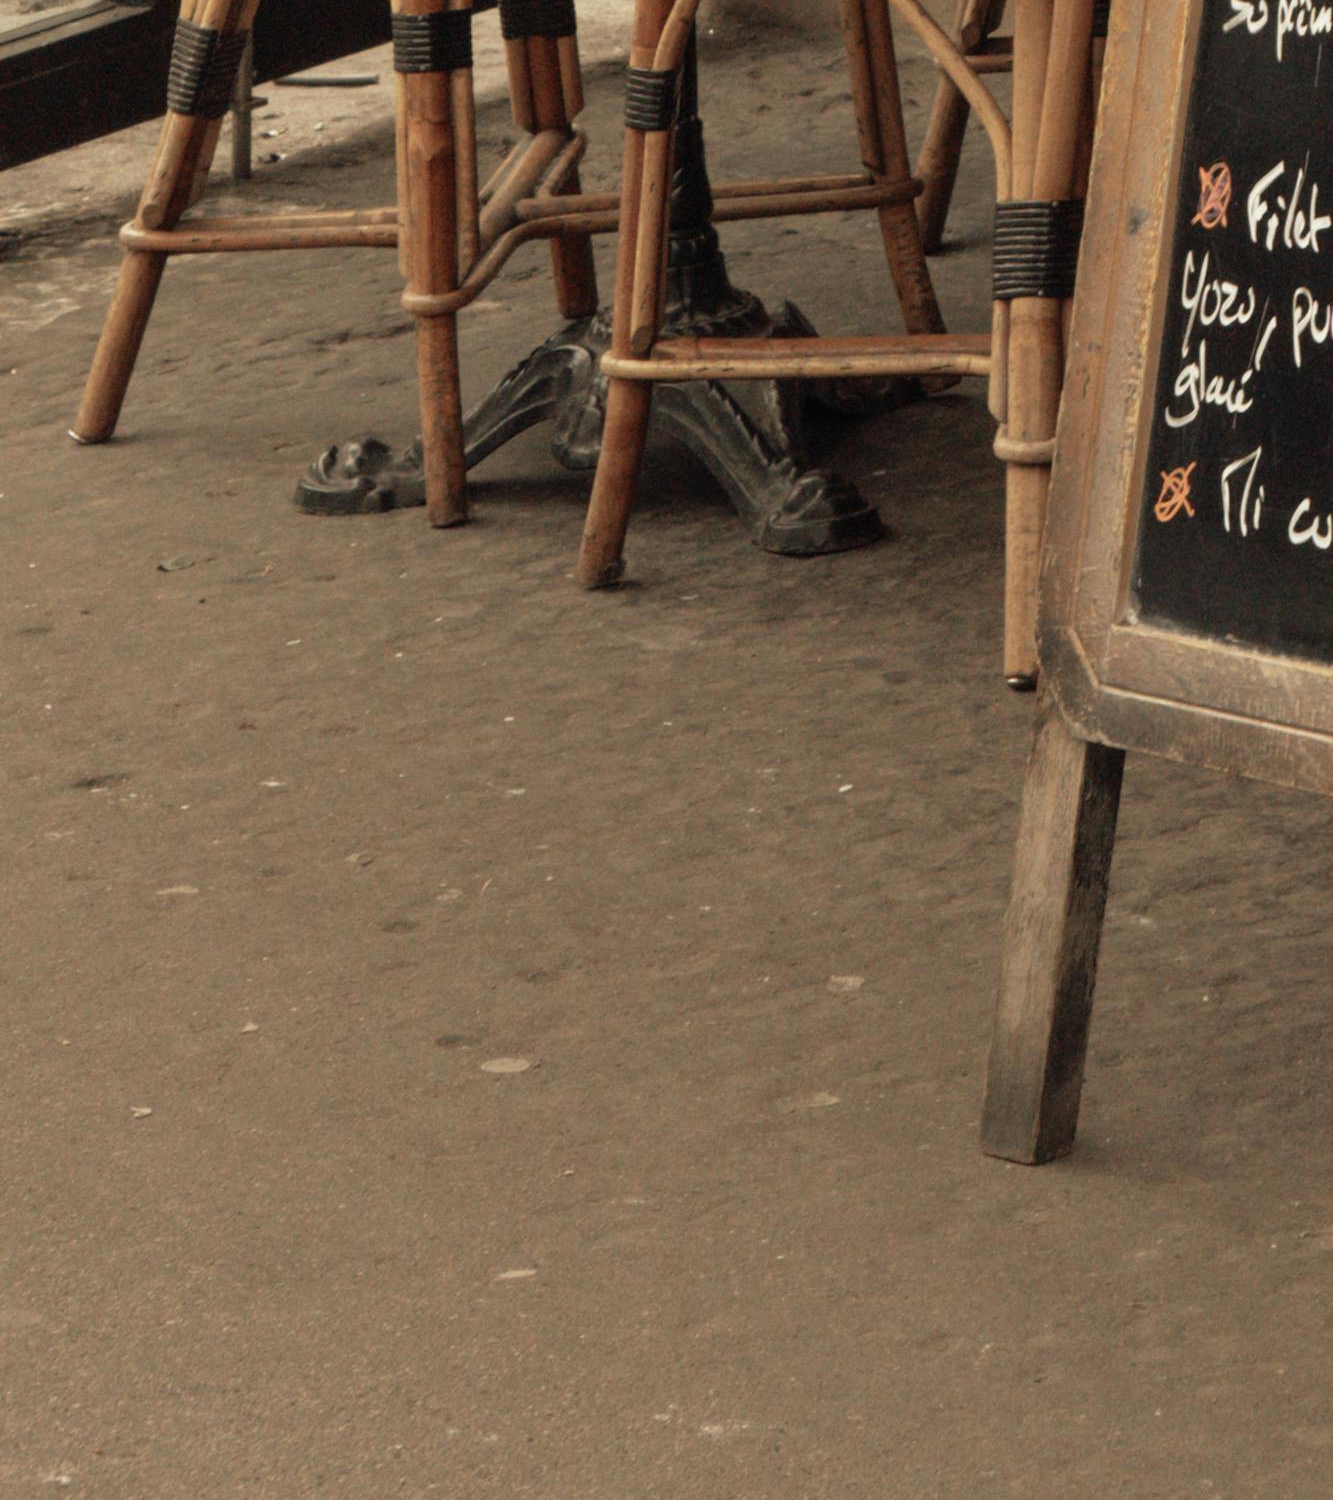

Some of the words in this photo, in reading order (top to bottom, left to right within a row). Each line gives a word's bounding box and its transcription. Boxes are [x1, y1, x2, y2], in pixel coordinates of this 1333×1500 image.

[1248, 161, 1331, 253] Filet
[1165, 340, 1254, 428] glacé
[1221, 446, 1262, 538] Mi
